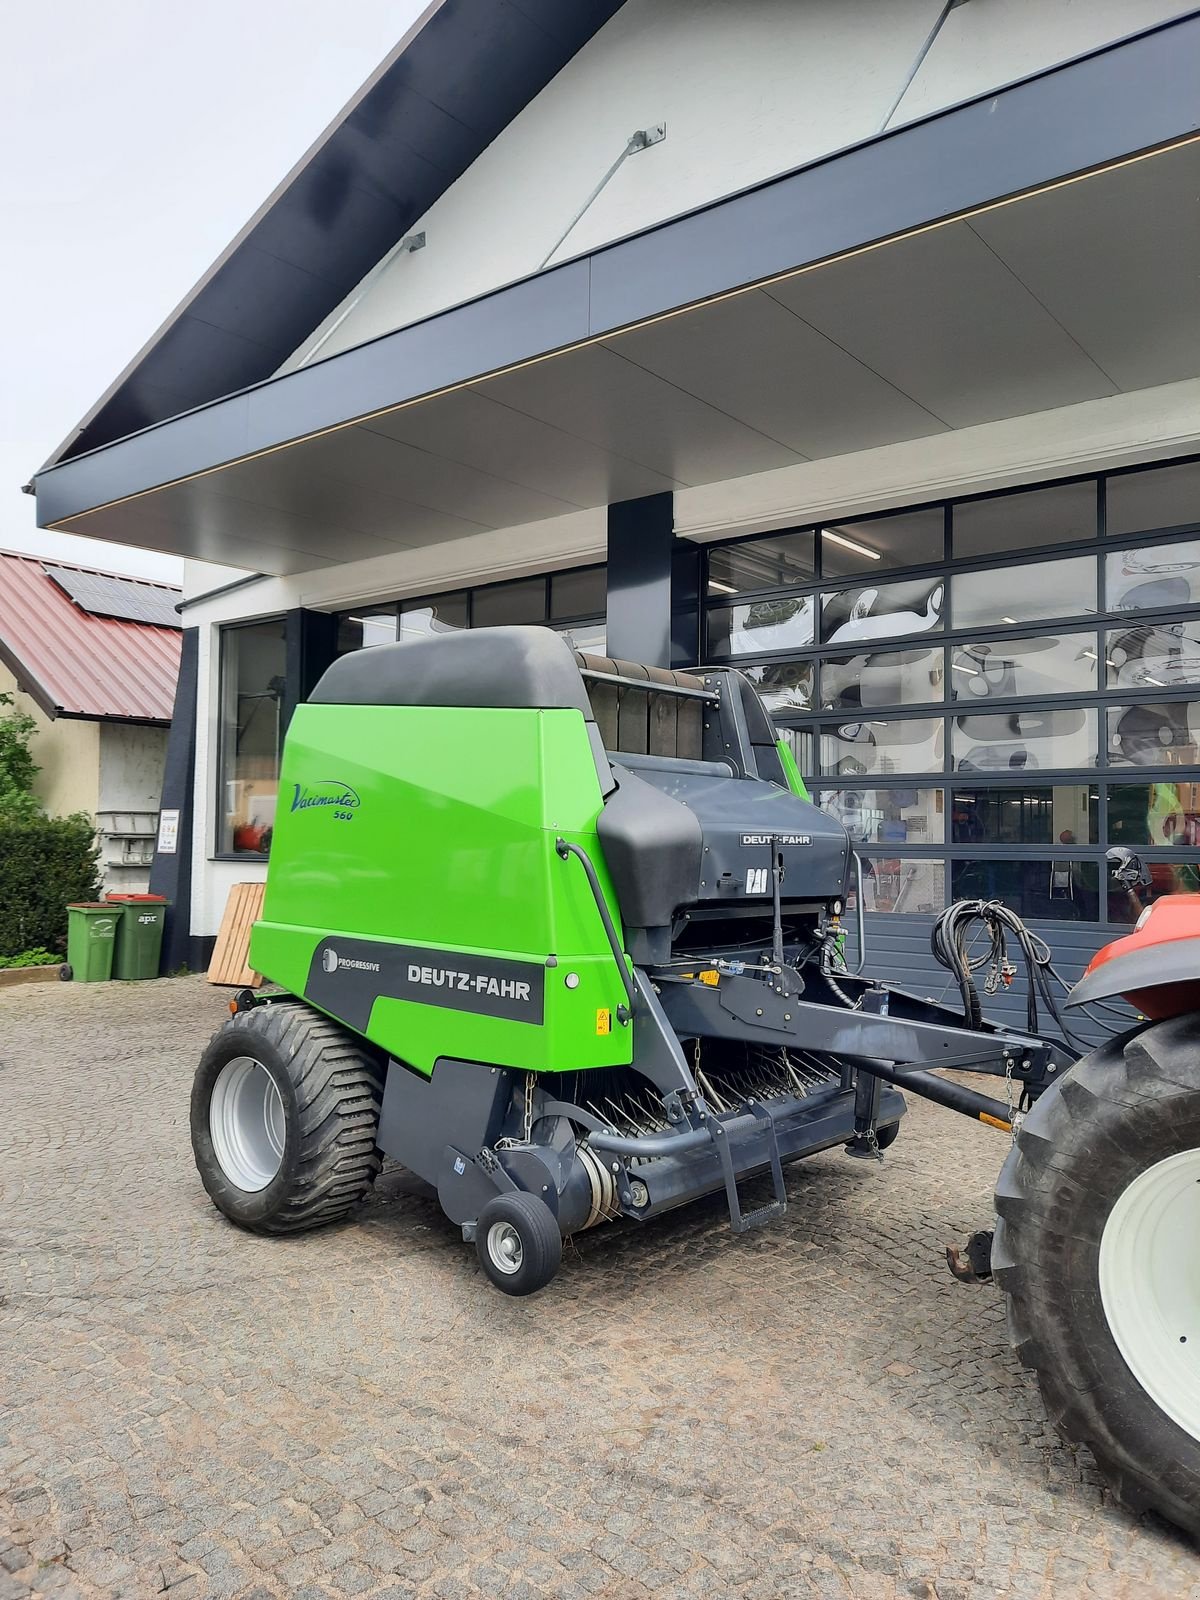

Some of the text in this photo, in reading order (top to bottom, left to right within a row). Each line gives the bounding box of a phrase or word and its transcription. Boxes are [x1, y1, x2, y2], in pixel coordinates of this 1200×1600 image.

[333, 810, 353, 821] 560
[743, 835, 810, 844] DEUT-FAHR
[138, 915, 157, 925] apr
[338, 957, 380, 972] PROGRESSIVE
[407, 964, 531, 1001] DEUTZ-FAHR
